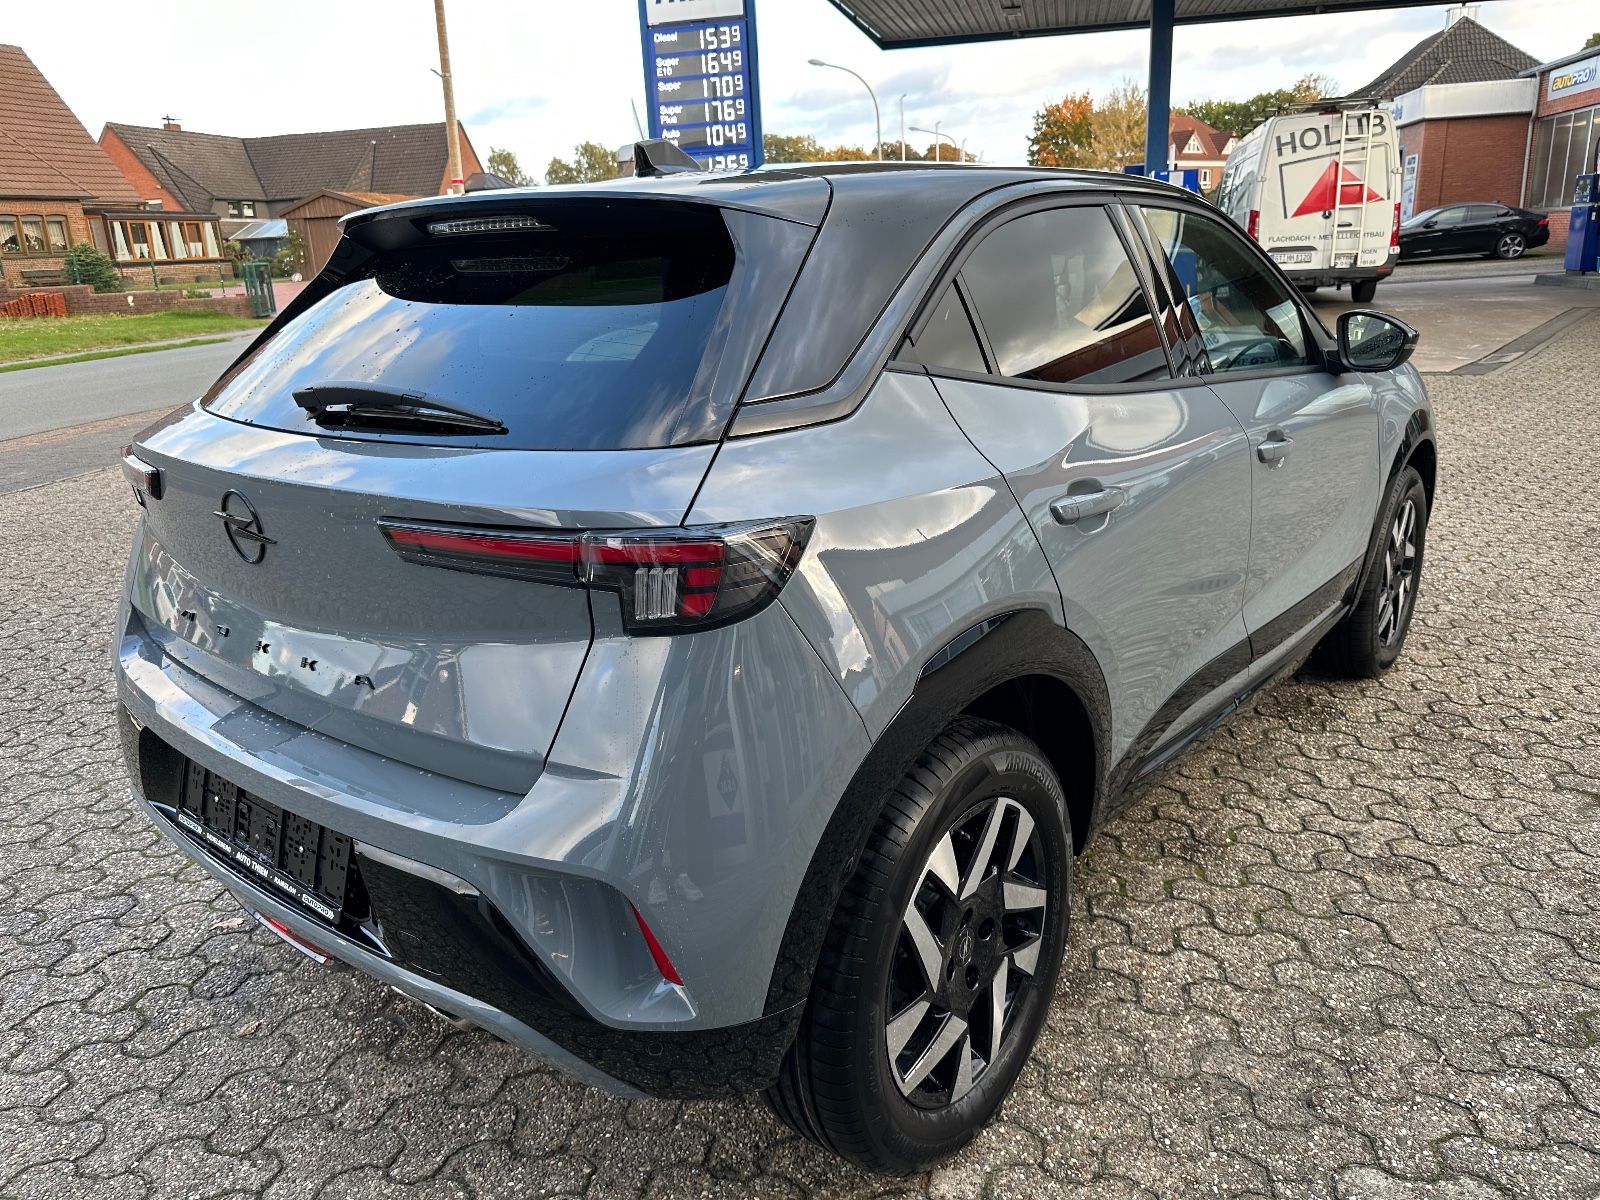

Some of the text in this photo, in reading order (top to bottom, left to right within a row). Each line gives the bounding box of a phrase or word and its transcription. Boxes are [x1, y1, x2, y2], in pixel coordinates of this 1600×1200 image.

[653, 32, 678, 43] Diesel
[655, 57, 680, 68] Super
[656, 67, 673, 77] E10
[657, 81, 682, 92] Super
[659, 105, 683, 116] Super
[660, 115, 678, 125] Plus
[661, 129, 681, 139] Auto
[1268, 234, 1311, 243] FLACHDACH
[181, 609, 376, 690] MOKKA
[235, 851, 251, 867] AUTO
[251, 860, 269, 878] THIEN
